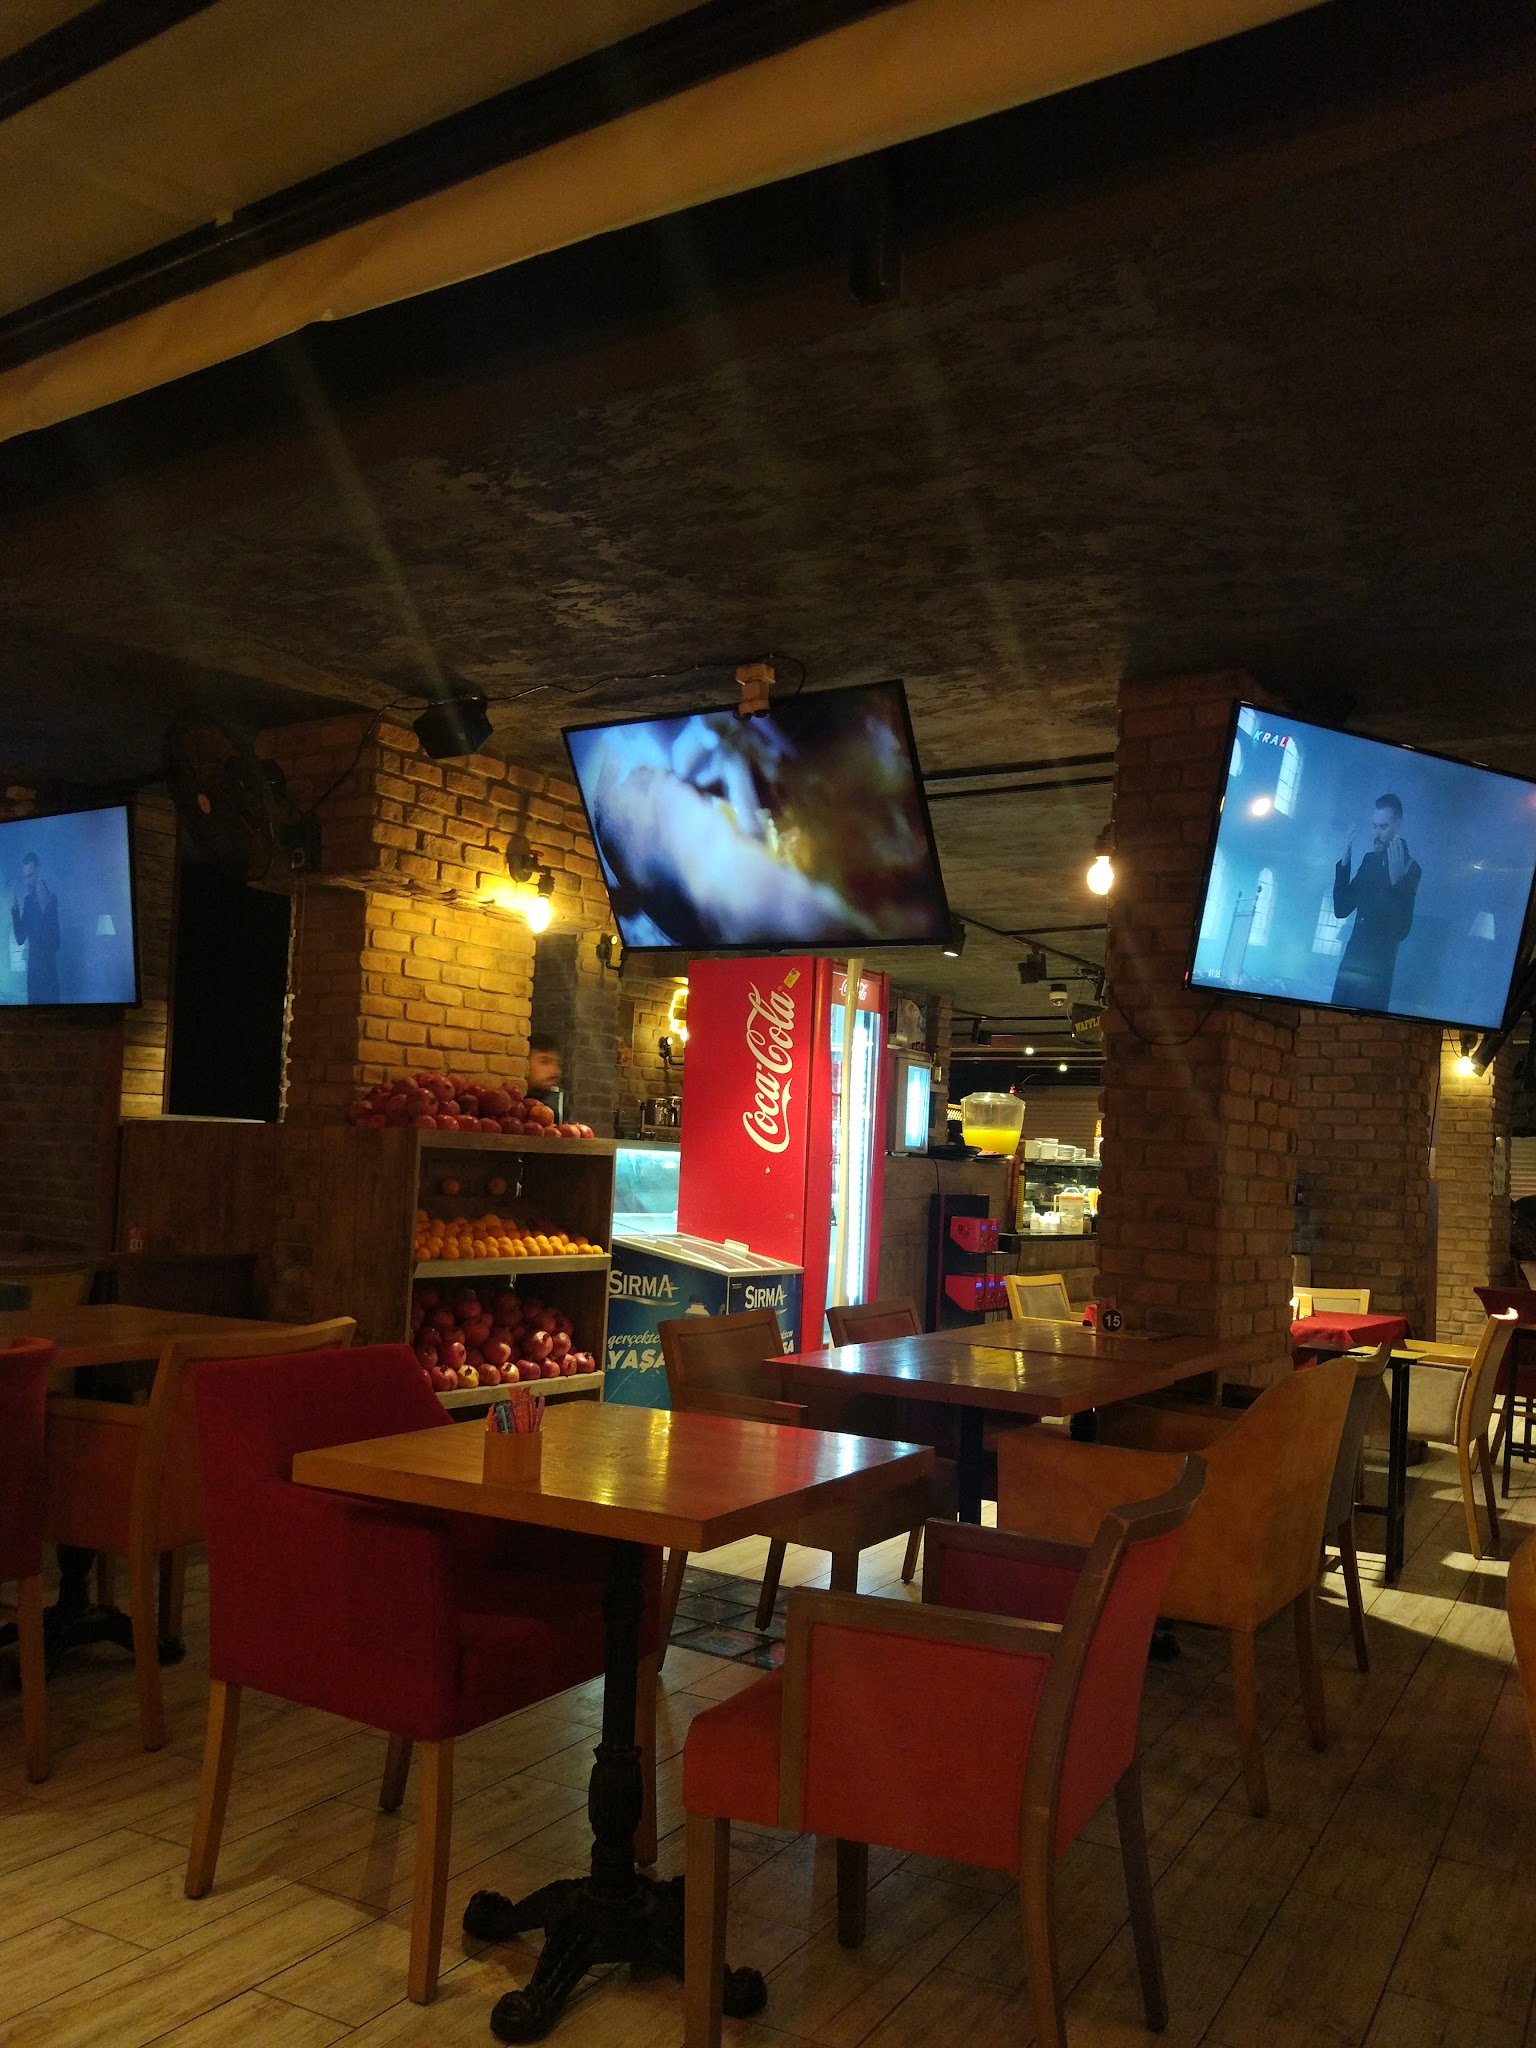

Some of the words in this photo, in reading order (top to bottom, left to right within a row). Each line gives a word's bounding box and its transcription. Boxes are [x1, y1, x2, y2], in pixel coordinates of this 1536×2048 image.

[1253, 730, 1288, 748] KRAL
[743, 981, 795, 1153] Coca-Cola
[608, 1269, 679, 1298] SIRMA
[744, 1285, 787, 1309] SIRMA
[1105, 1315, 1120, 1328] 15
[607, 1330, 661, 1349] gerçekte
